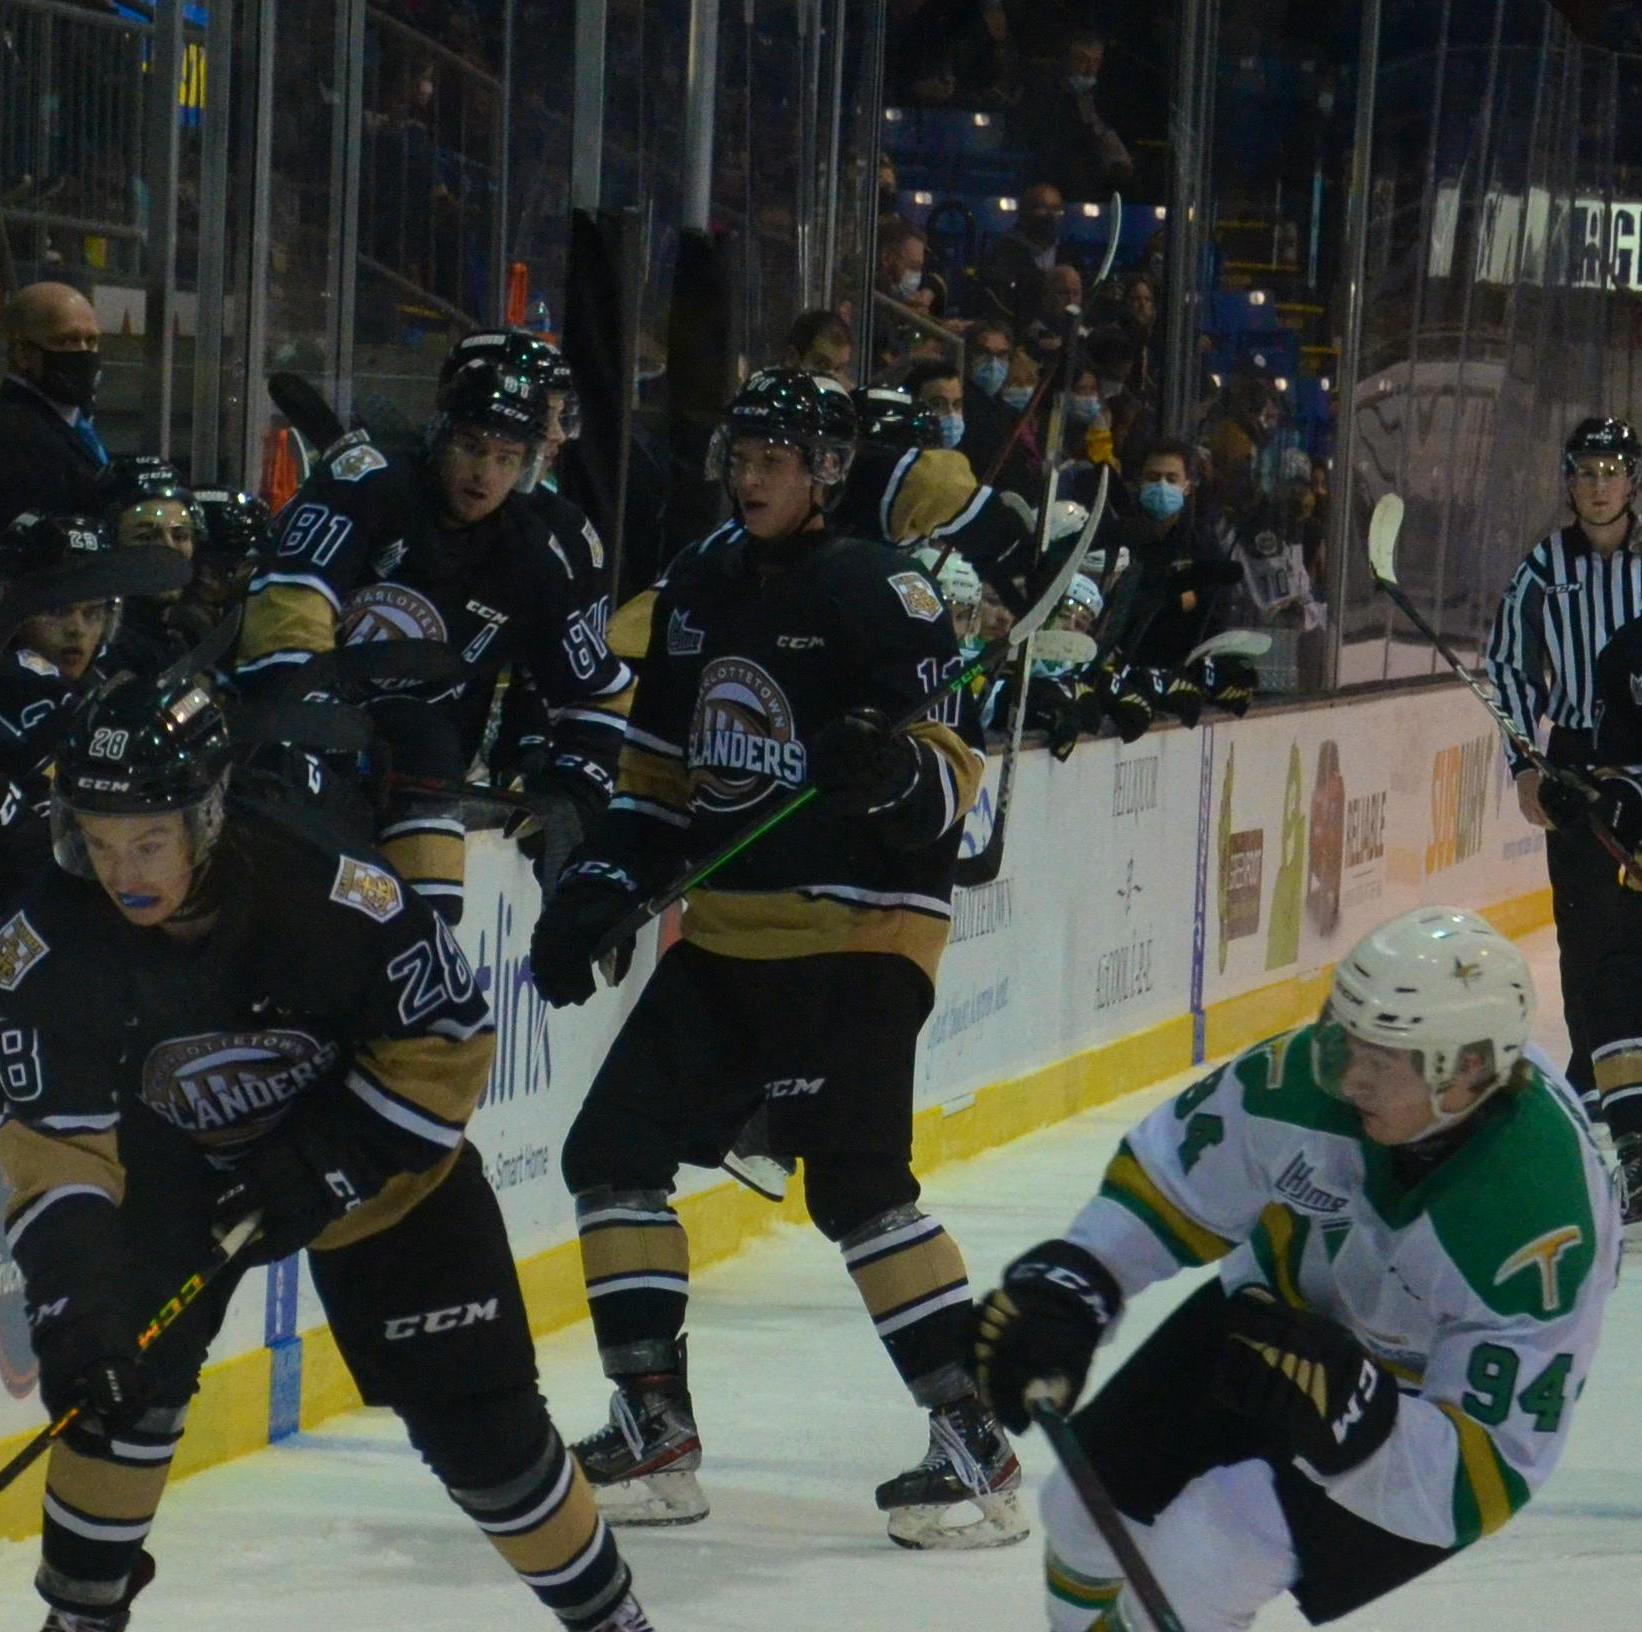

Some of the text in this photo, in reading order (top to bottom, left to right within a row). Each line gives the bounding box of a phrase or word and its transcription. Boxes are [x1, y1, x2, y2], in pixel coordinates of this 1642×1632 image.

[277, 502, 354, 568] 81
[776, 634, 826, 649] CCM
[88, 727, 129, 760] 28
[77, 777, 131, 793] CCM
[382, 1296, 500, 1344] CCM
[1461, 1341, 1573, 1434] 94
